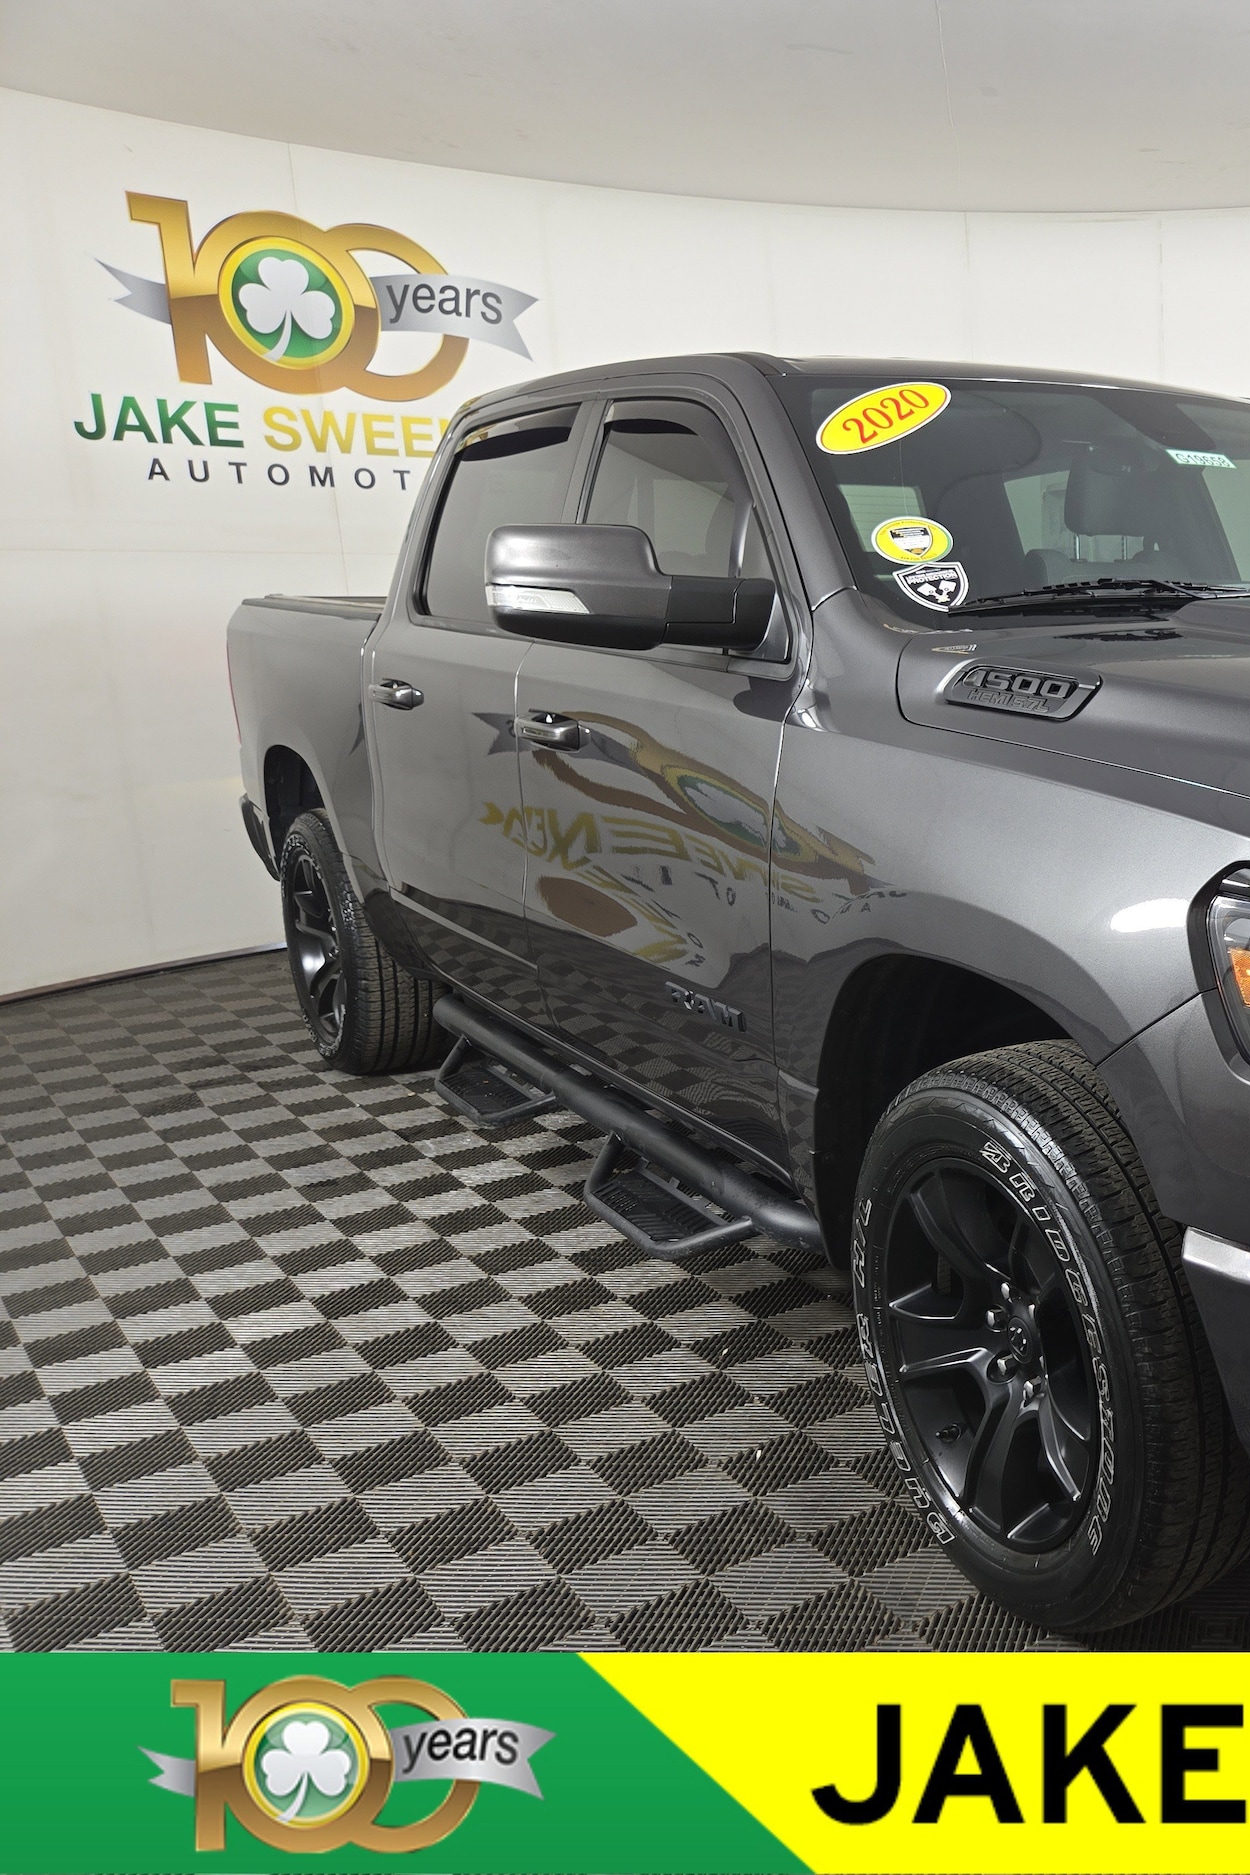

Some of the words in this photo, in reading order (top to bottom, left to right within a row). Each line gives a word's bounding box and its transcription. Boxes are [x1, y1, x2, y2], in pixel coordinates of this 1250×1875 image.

[385, 280, 503, 325] years
[74, 392, 245, 448] JAKE
[263, 405, 449, 458] SWEE
[842, 389, 929, 444] 2020
[148, 457, 411, 491] AUTOMOT
[963, 668, 1073, 699] 1500
[967, 688, 1011, 708] HEMI
[665, 981, 747, 1033] RAM
[979, 1141, 1115, 1556] BRIDGESTONE
[856, 1312, 956, 1545] DUELER
